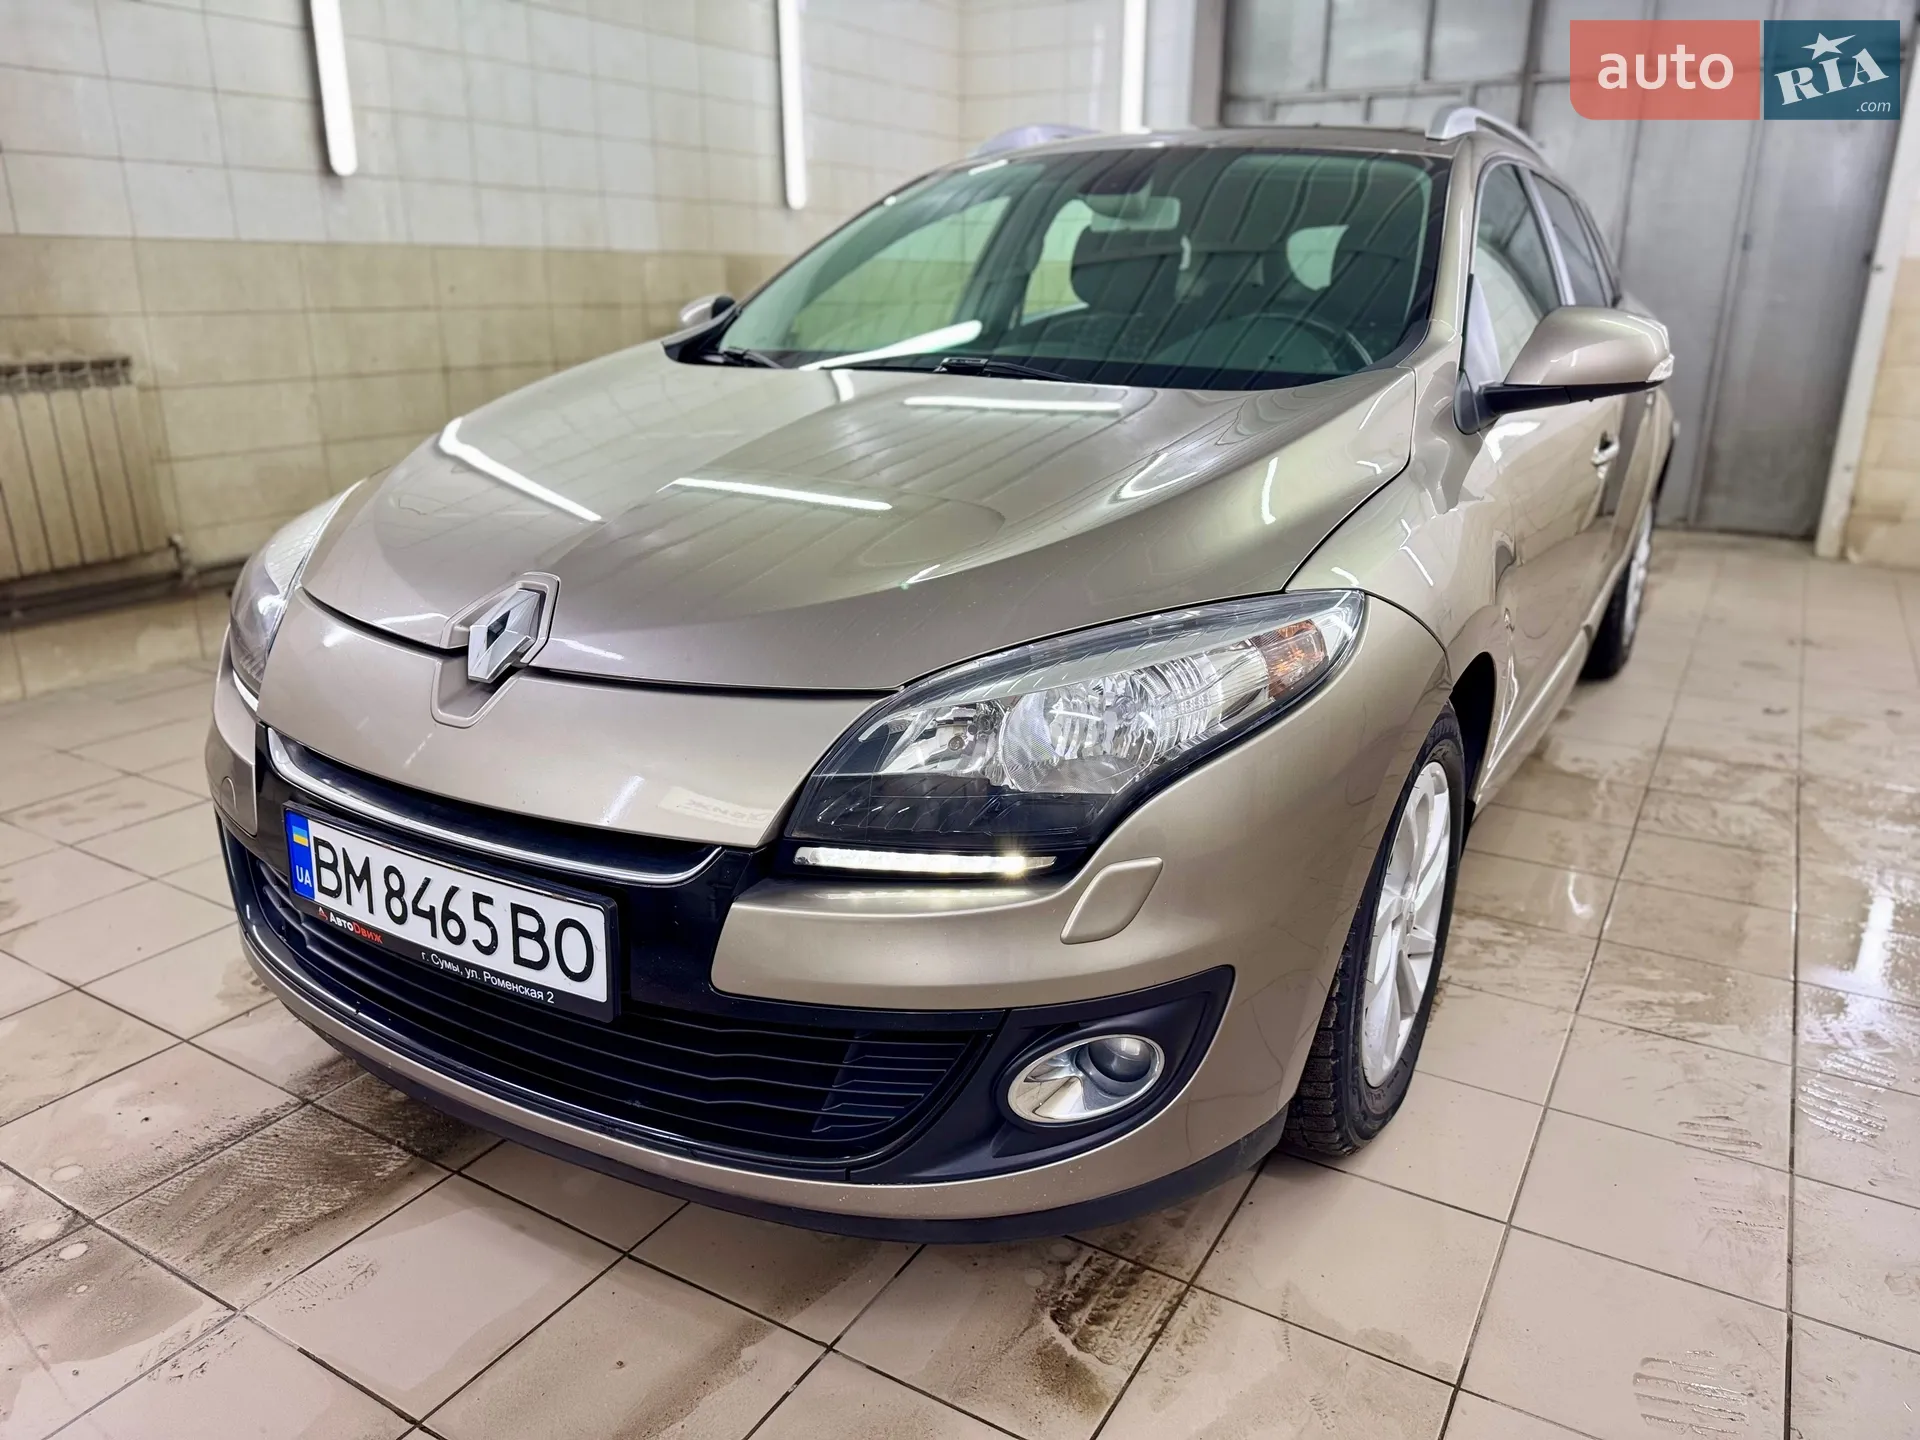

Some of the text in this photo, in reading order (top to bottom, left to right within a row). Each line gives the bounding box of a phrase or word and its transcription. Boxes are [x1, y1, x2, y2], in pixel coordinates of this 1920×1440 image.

[295, 864, 313, 888] UA
[421, 951, 555, 1004] г. Сумы, ул. Роменская 2
